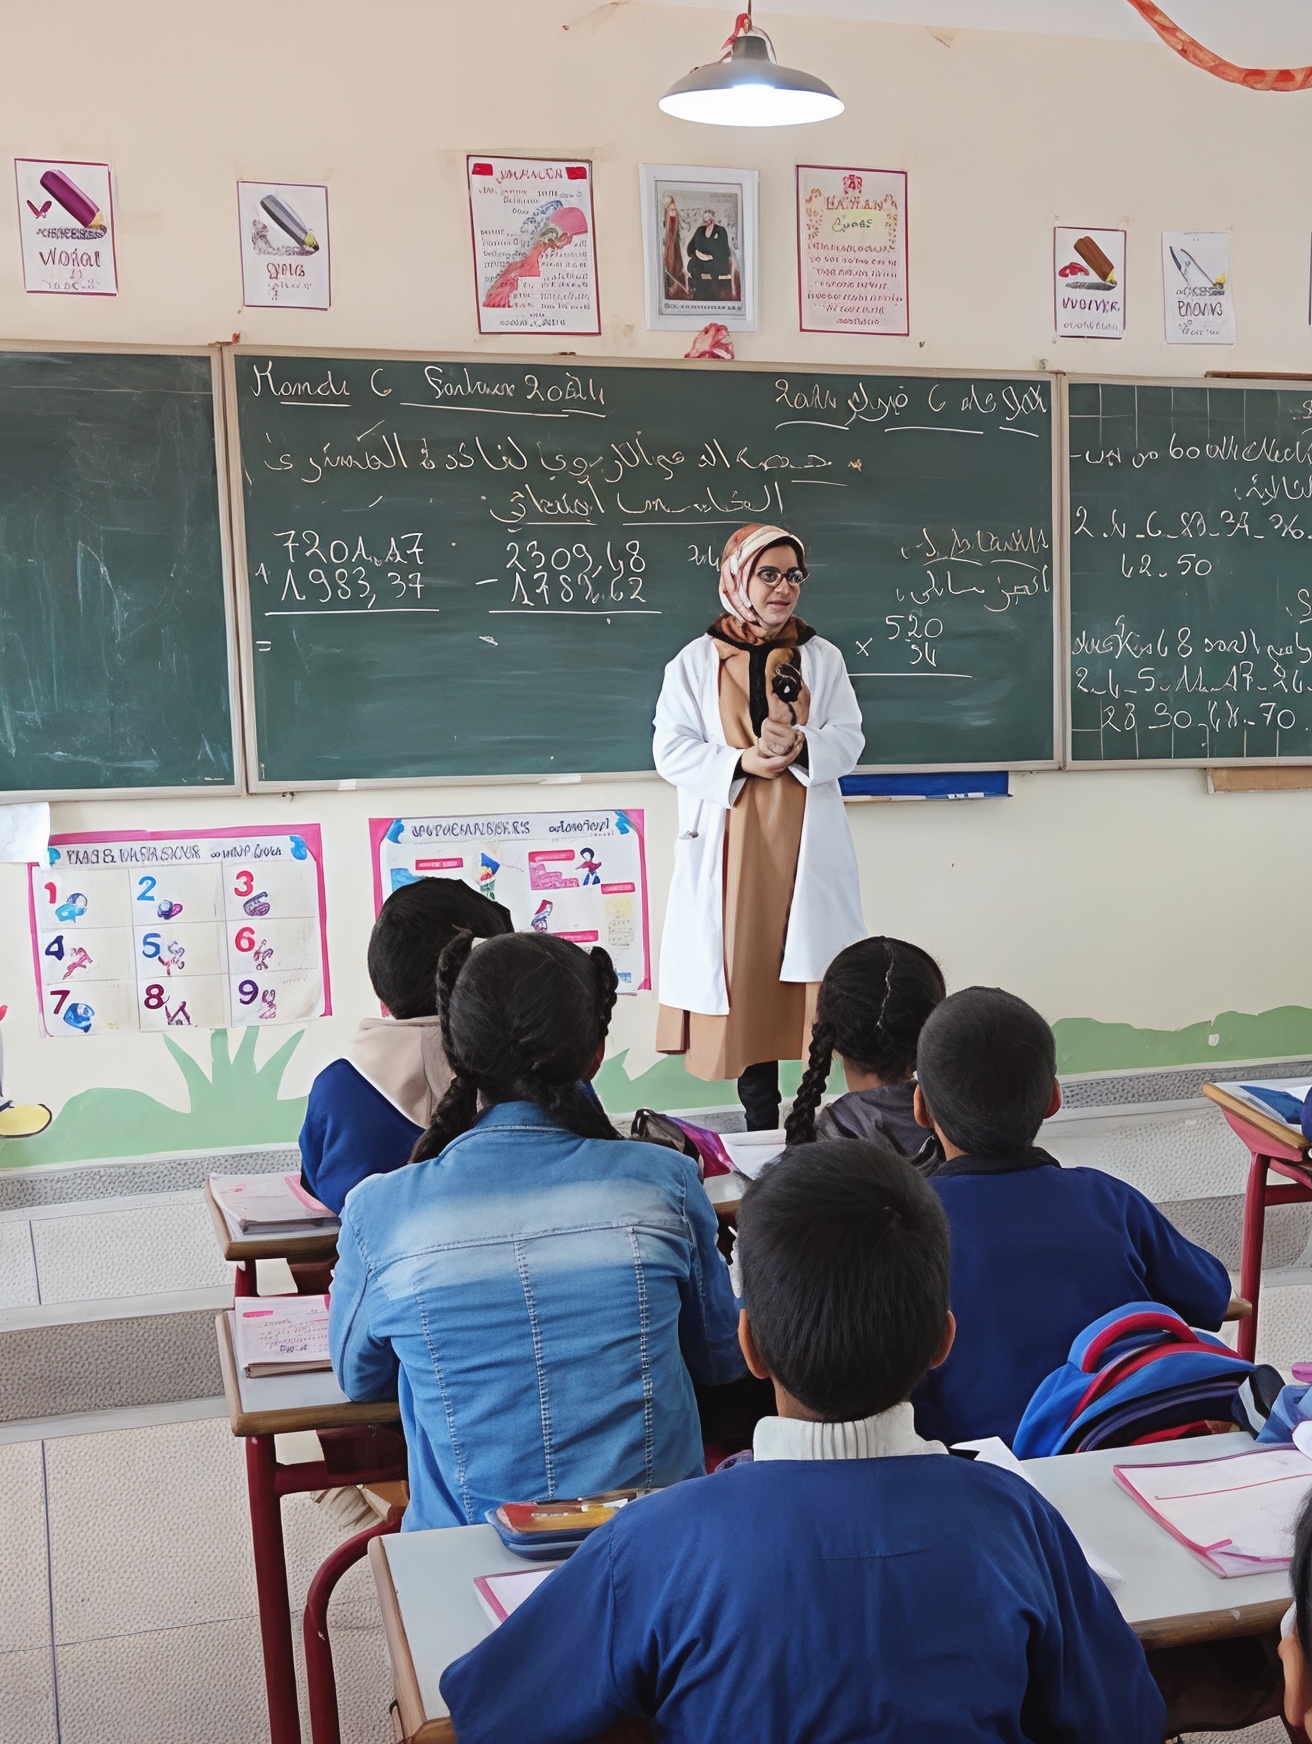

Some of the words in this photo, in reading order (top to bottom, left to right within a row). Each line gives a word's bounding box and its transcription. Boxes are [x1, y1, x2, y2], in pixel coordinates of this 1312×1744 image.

[886, 614, 943, 640] 520
[44, 881, 57, 905] 1
[136, 875, 157, 902] 2
[234, 870, 255, 898] 3
[44, 934, 65, 961] 4
[142, 932, 161, 959] 5
[234, 926, 256, 953] 6
[50, 989, 71, 1015] 7
[143, 983, 166, 1010] 8
[238, 979, 259, 1005] 9
